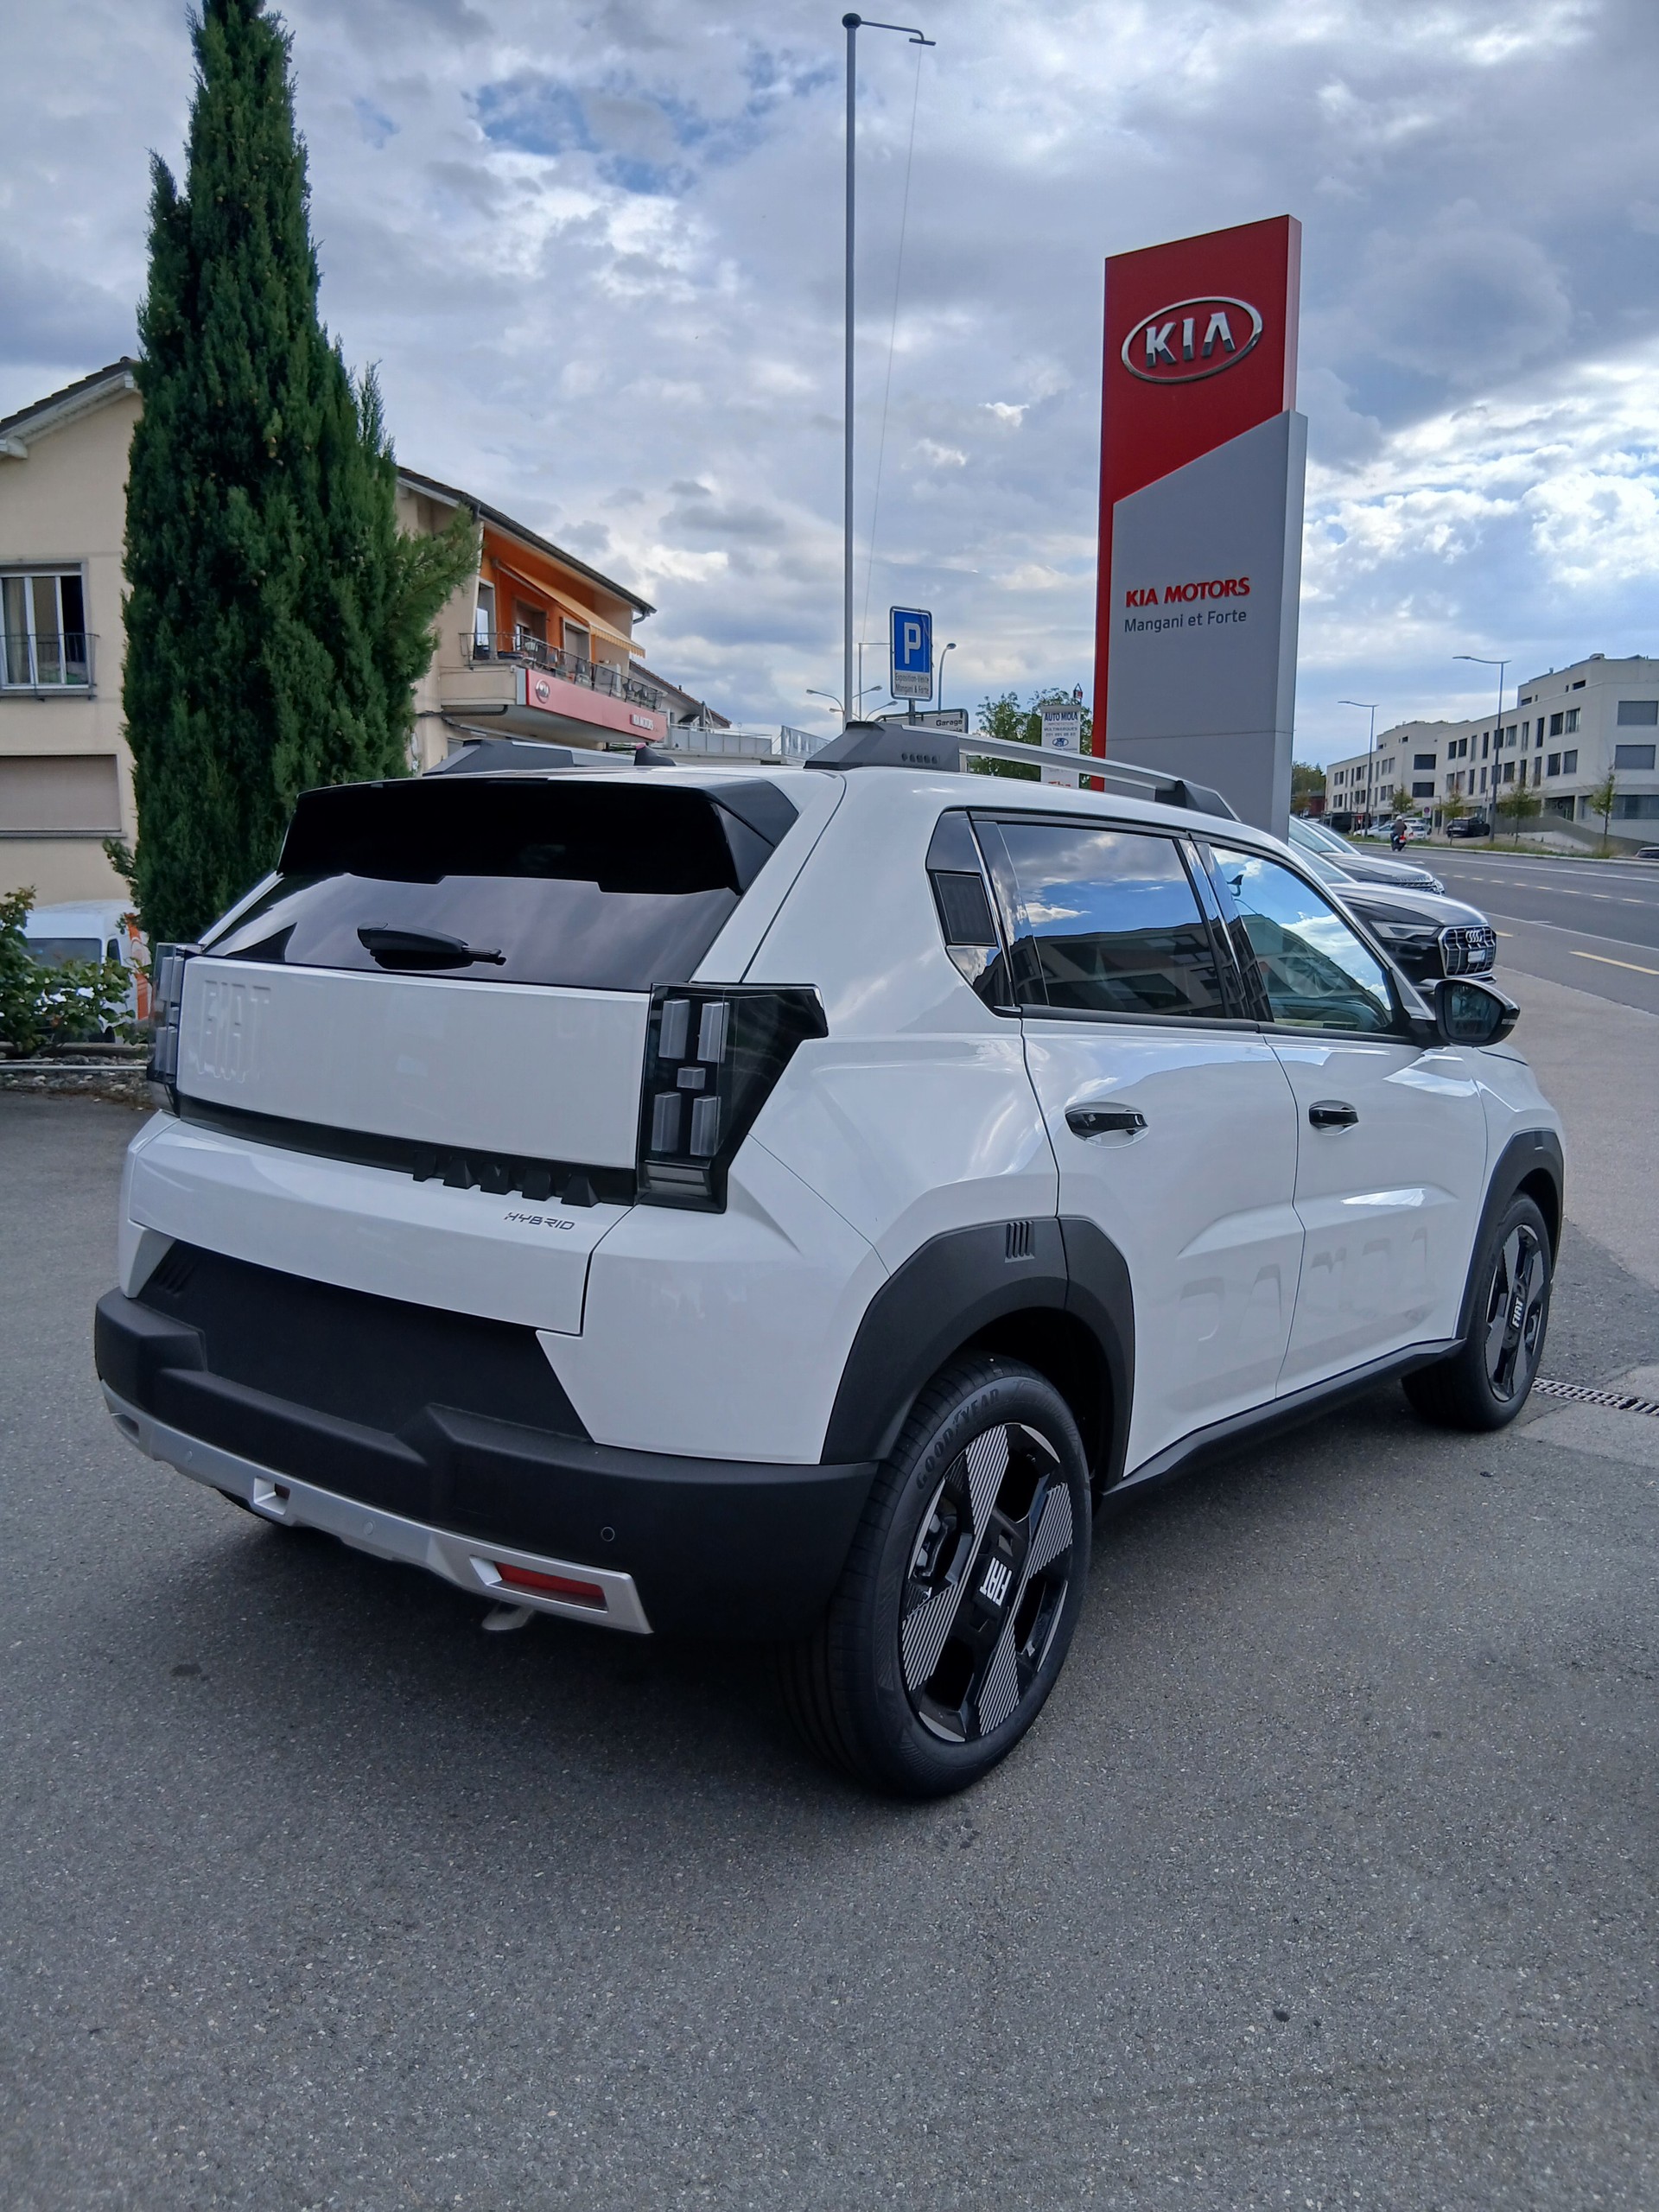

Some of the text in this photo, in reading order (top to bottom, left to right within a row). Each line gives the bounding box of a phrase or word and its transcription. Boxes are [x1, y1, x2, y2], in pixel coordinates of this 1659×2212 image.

[1146, 311, 1236, 369] KIA
[1126, 576, 1250, 607] KIA MOTORS
[1124, 609, 1247, 632] Mangani et Forte
[903, 621, 922, 664] P
[1044, 711, 1060, 721] AUTO
[504, 1211, 575, 1231] HYBRID
[1511, 1297, 1525, 1328] FIAT
[916, 1389, 999, 1491] GOODYEAR
[979, 1556, 1013, 1606] FIAT
